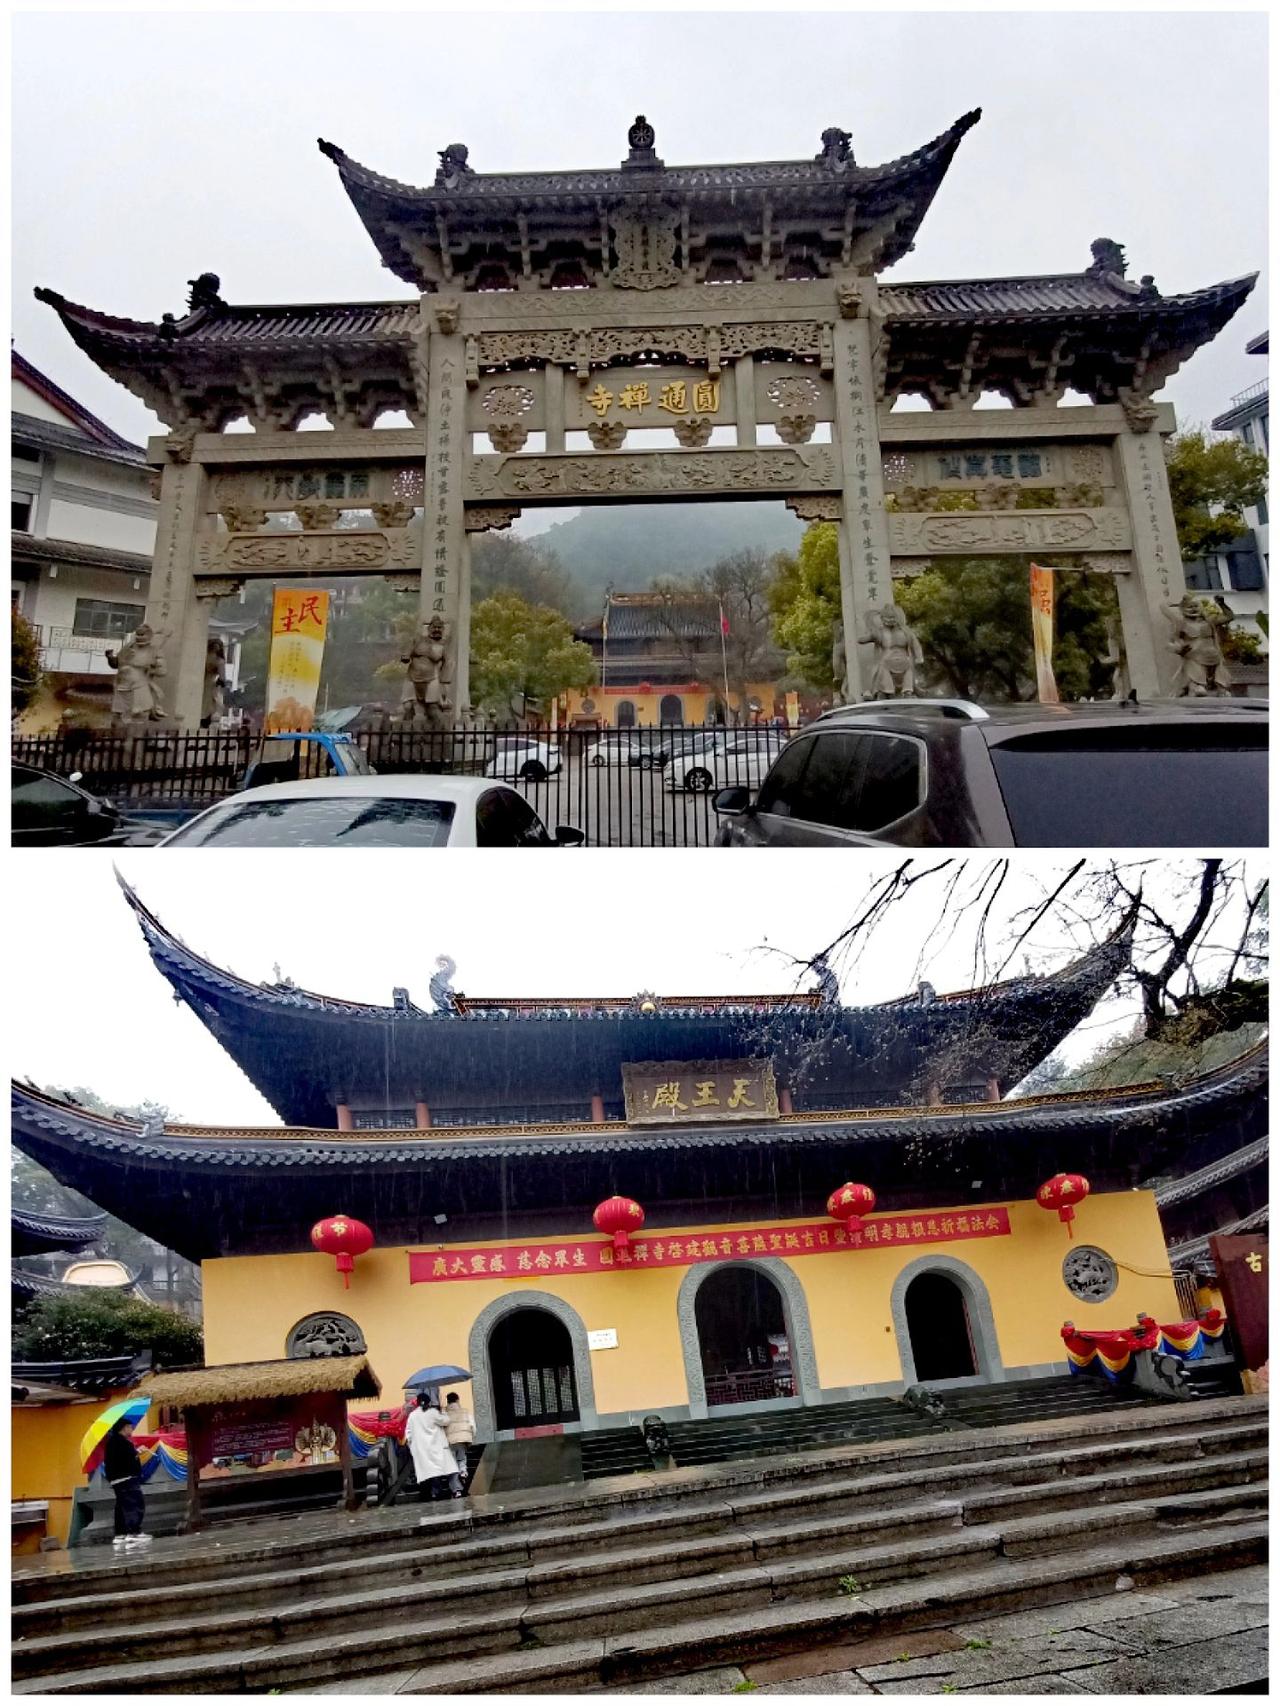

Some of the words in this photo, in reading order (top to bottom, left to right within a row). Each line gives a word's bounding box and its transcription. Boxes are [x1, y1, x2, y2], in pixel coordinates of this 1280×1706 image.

[586, 380, 720, 417] 圓通禪寺
[274, 595, 323, 634] 民主
[651, 1078, 756, 1111] 天王殿
[432, 1254, 507, 1277] 廣大靈感
[1244, 1251, 1263, 1273] 古
